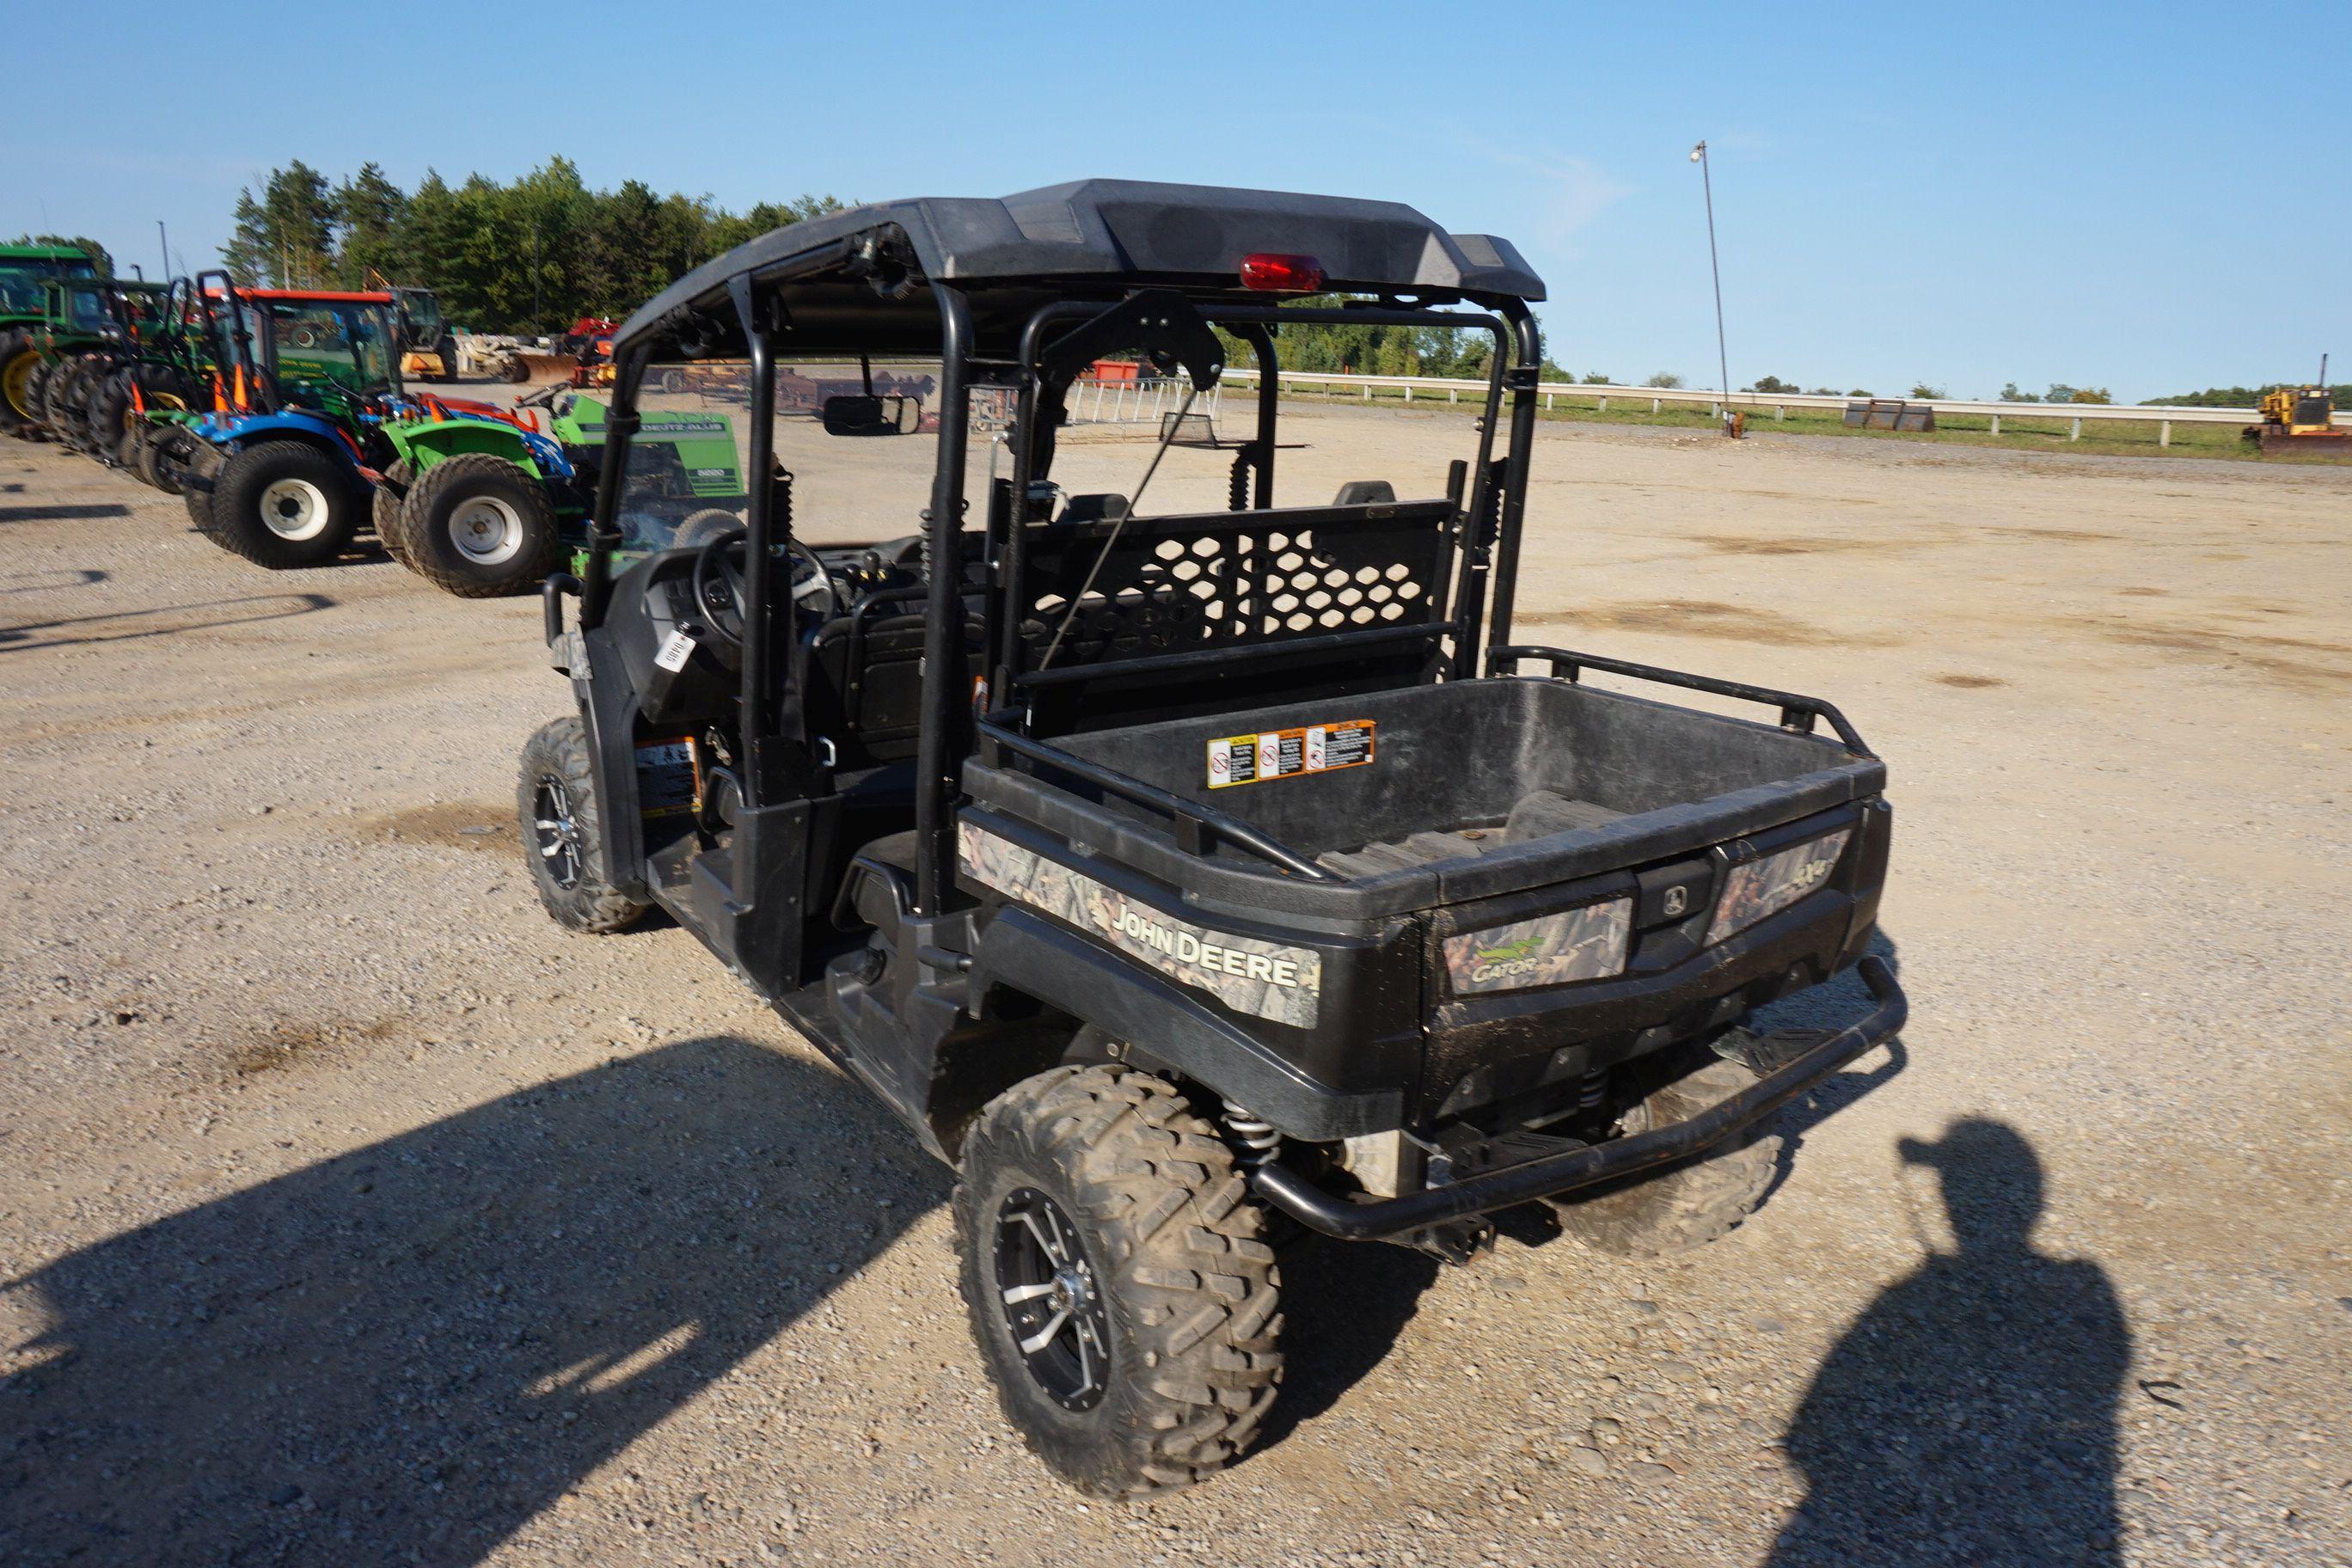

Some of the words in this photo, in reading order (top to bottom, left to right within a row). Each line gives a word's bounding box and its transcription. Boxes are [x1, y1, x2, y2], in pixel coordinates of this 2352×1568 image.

[1112, 903, 1173, 956] JOHN
[1176, 929, 1298, 988] DEERE
[1472, 957, 1538, 983] GATOR
